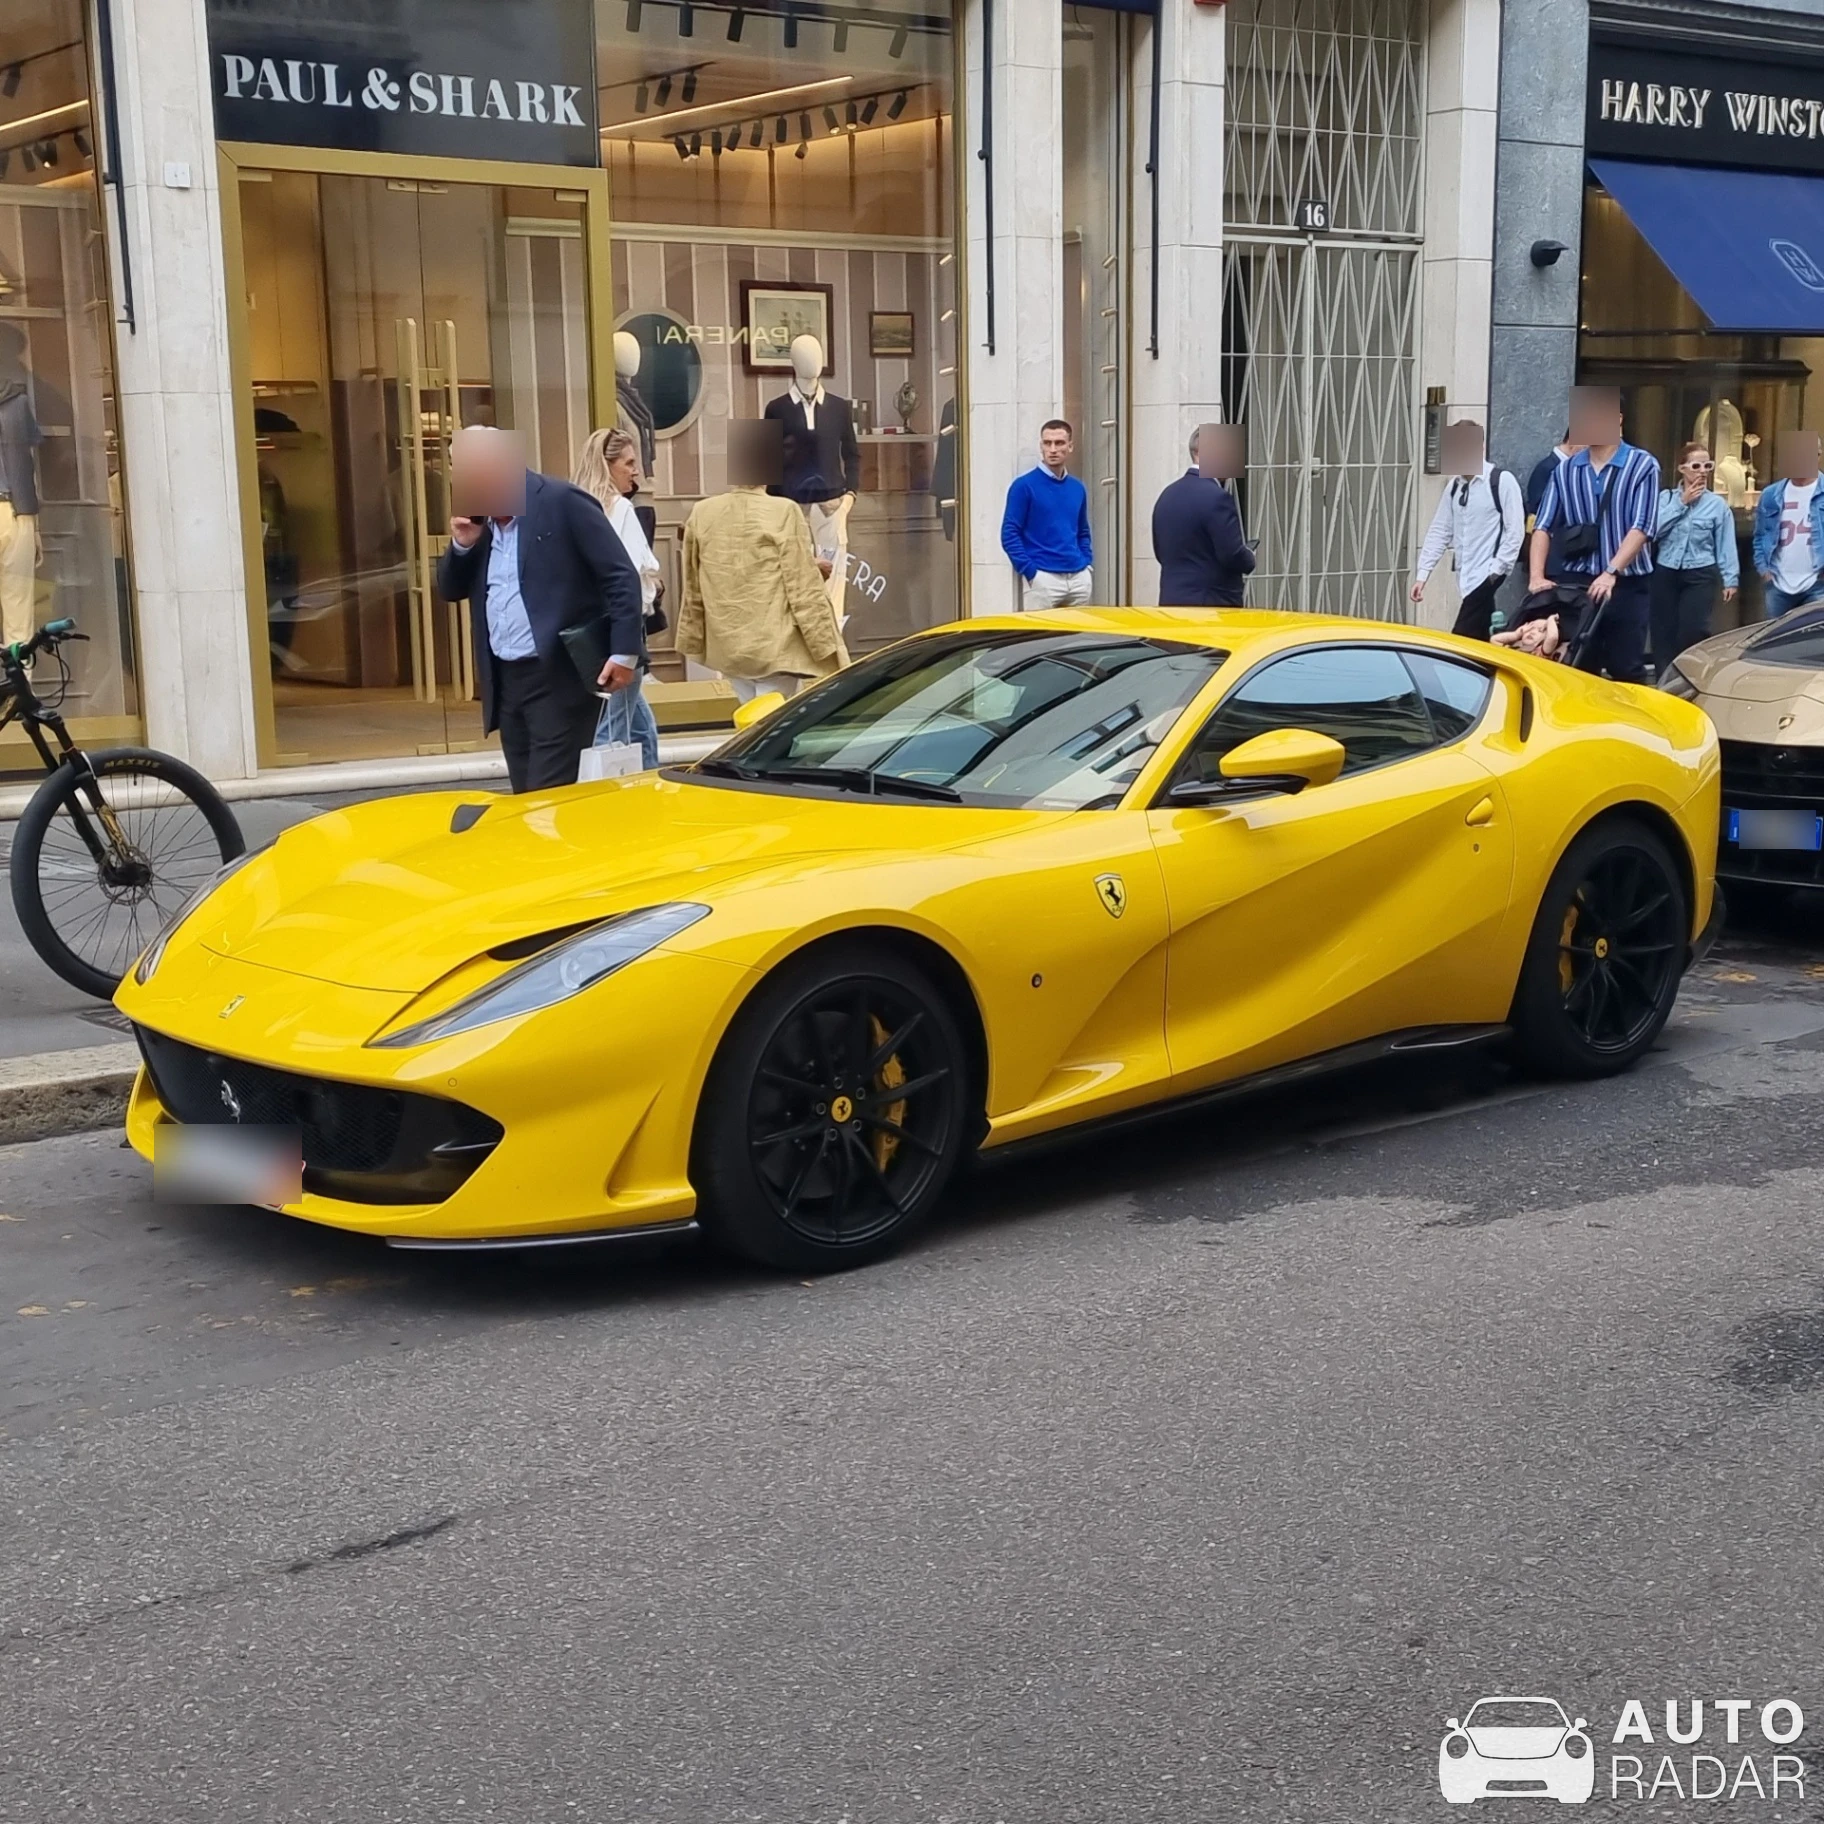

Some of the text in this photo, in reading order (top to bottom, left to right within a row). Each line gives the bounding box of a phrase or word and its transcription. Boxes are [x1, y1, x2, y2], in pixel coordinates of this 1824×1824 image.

[221, 54, 586, 127] PAUL & SHARK
[1600, 79, 1824, 139] HARRY WINST
[1304, 202, 1326, 228] 16
